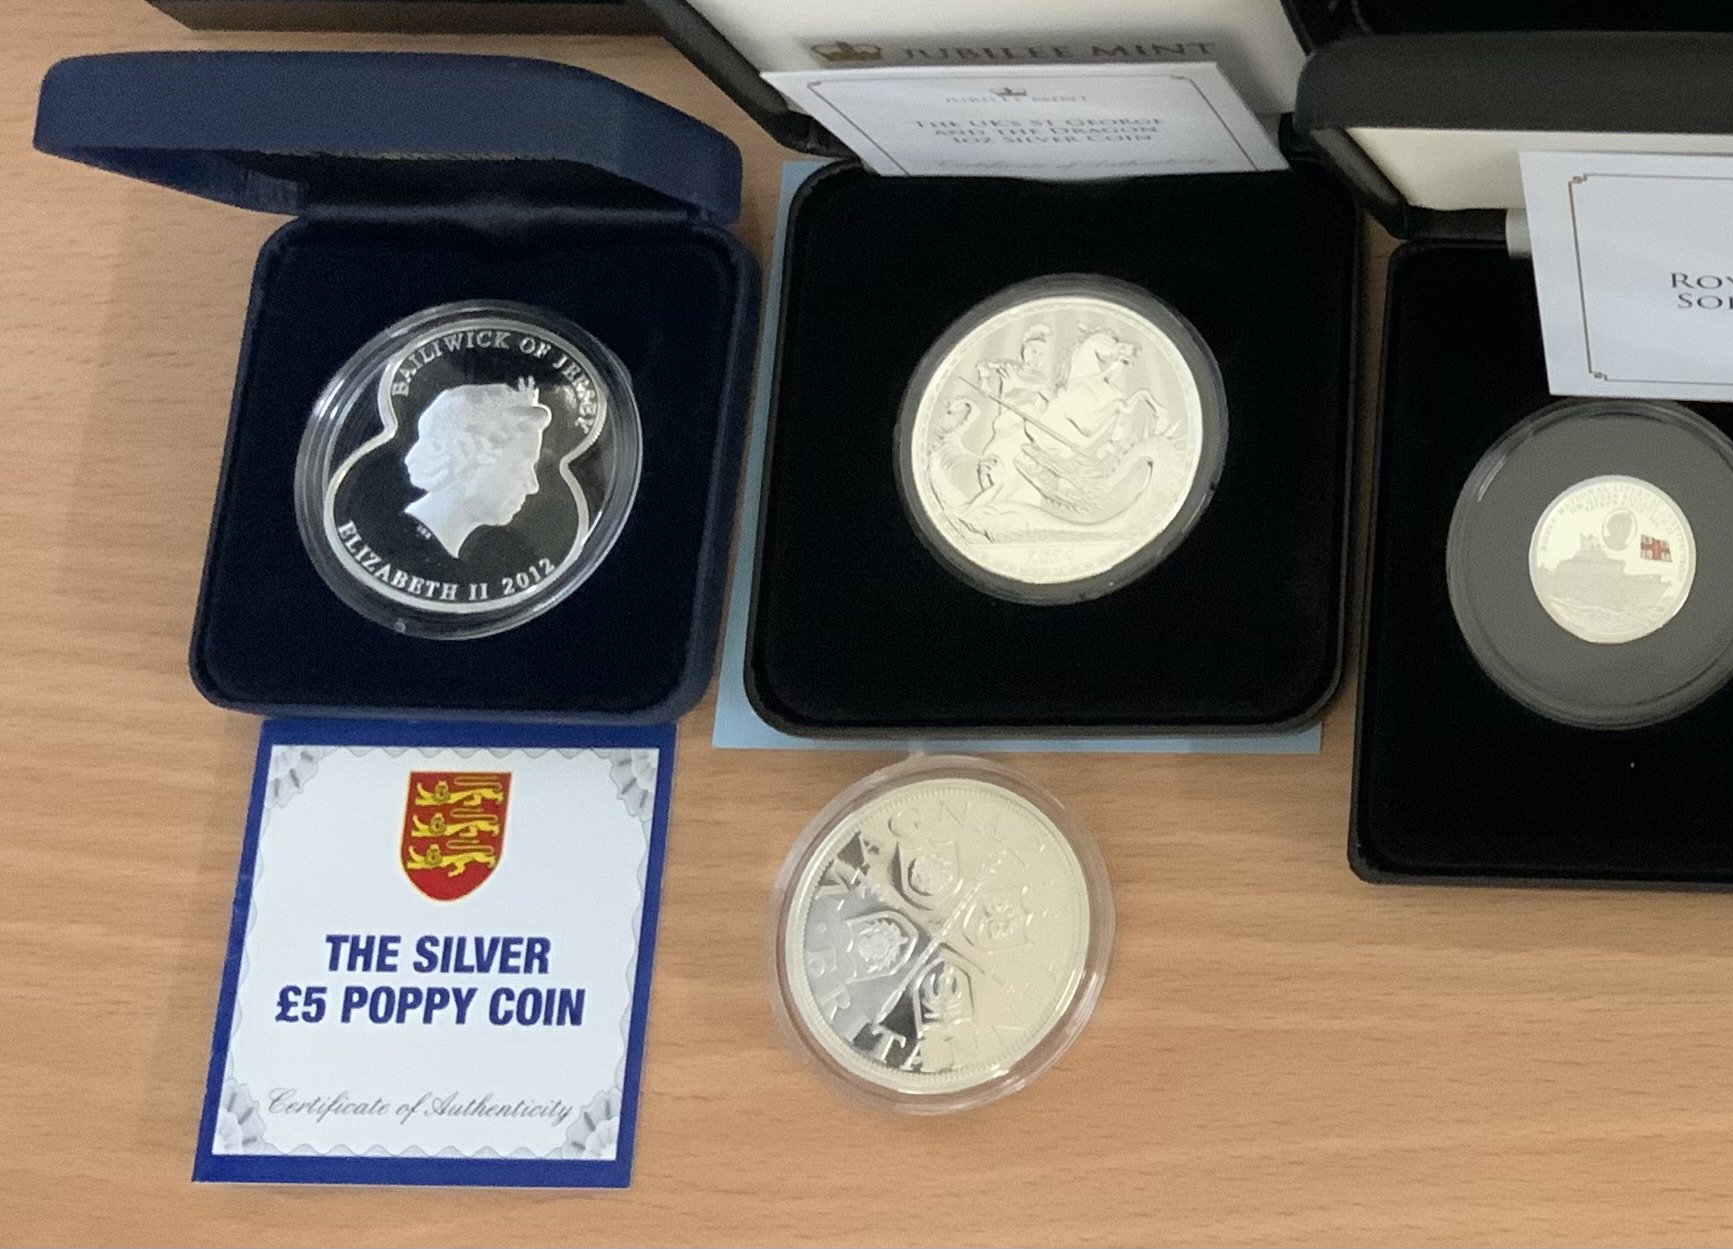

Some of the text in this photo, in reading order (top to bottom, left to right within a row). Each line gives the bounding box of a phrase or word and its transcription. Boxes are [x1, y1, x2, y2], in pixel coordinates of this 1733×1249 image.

[903, 42, 1217, 59] JUBILEE MINT
[1050, 126, 1159, 134] DRAGON
[1087, 134, 1153, 142] COIN
[392, 330, 598, 434] BAILIWICK OF JERSEY
[338, 520, 460, 601] ELIZABETH
[469, 582, 488, 601] II
[502, 558, 556, 596] 2012
[325, 934, 551, 974] THE SILVER
[275, 985, 586, 1026] £5 POPPY COIN
[268, 1088, 573, 1127] Certificate of Authenticity
